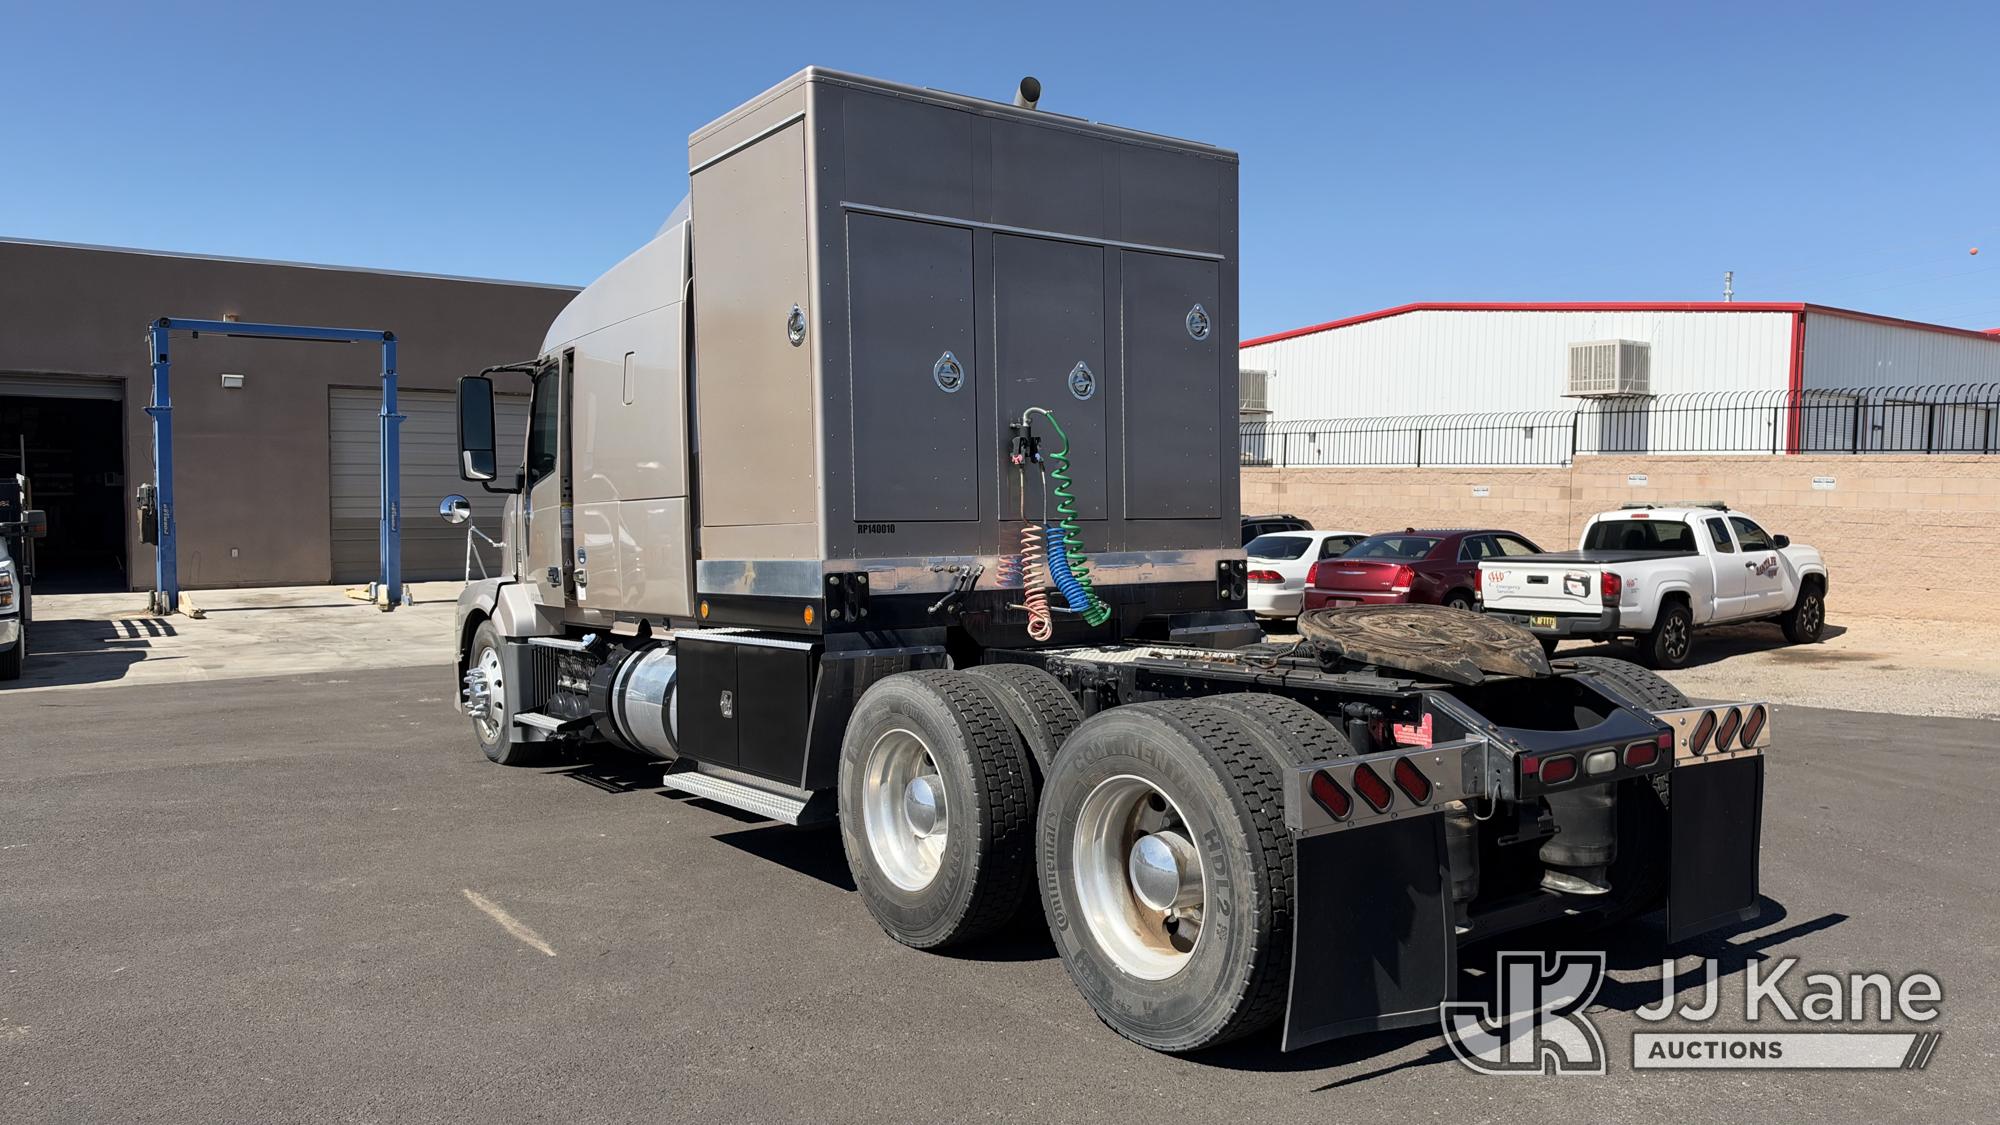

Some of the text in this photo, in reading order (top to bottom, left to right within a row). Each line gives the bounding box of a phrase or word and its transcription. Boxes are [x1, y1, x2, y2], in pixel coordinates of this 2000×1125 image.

[857, 523, 896, 535] RP140010
[1046, 823, 1068, 932] Continental
[1203, 827, 1233, 918] HDL2
